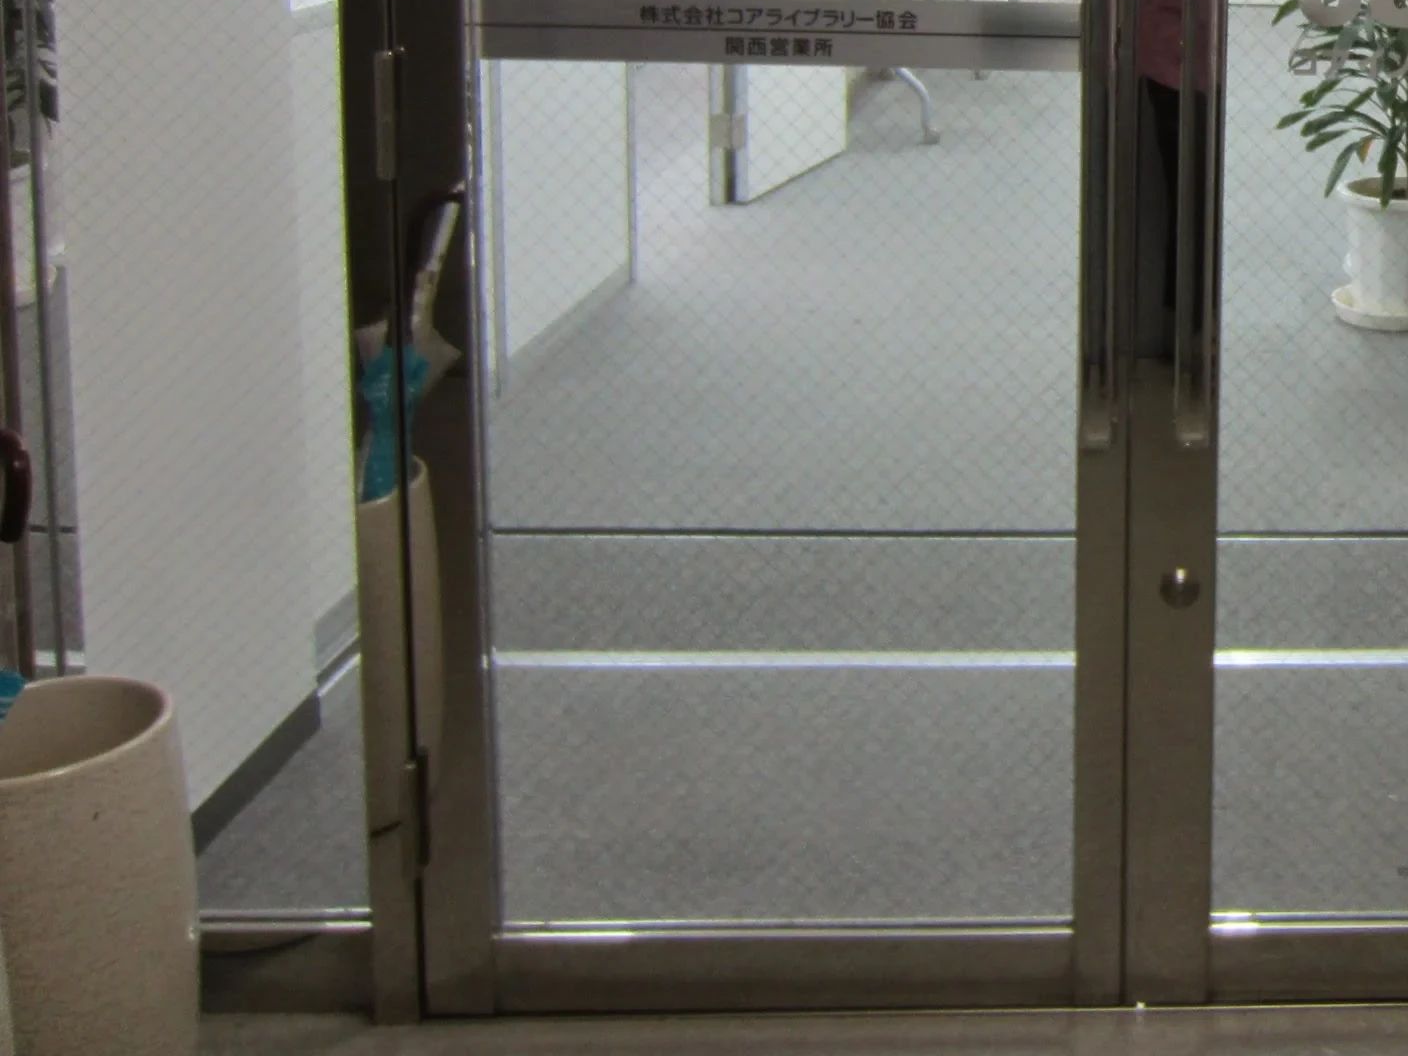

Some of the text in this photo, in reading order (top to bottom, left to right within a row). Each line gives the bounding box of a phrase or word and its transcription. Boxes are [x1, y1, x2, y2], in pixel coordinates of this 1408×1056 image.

[640, 5, 918, 30] 株式会社コアライブラリー協会
[725, 36, 833, 58] 関西営業所
